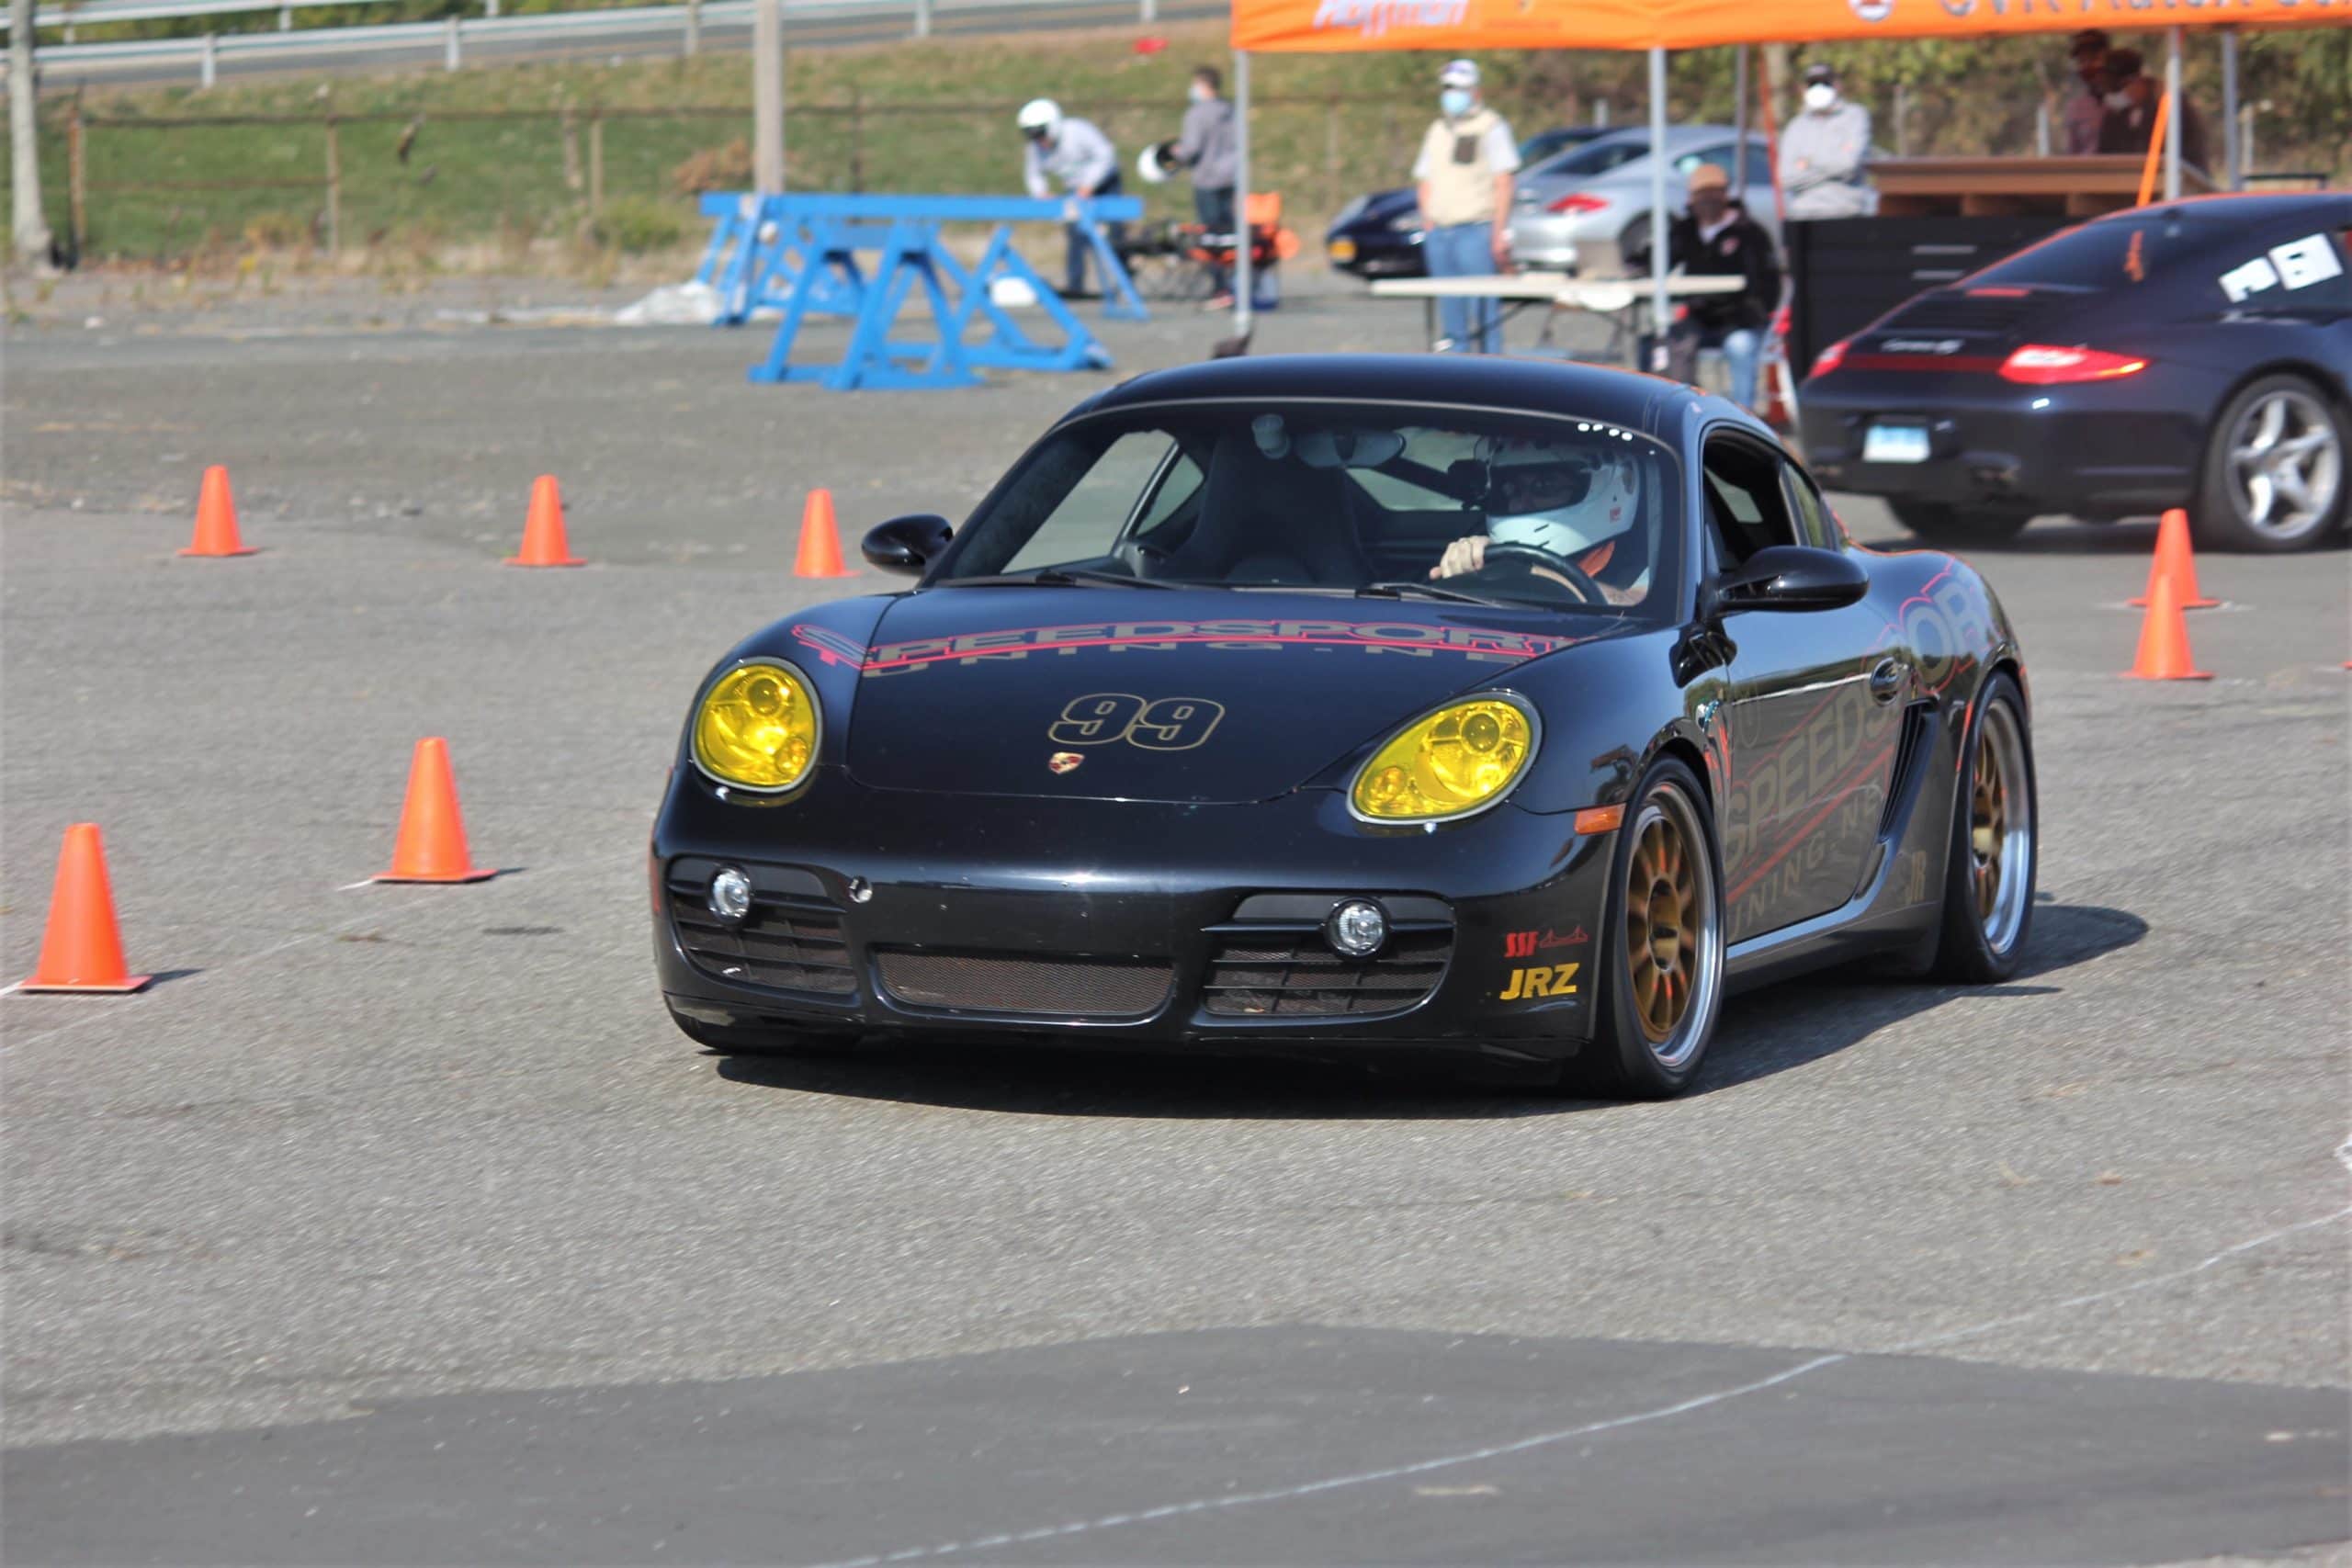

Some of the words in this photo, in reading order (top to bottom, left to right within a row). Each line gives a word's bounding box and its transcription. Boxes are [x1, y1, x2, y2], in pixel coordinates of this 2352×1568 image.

[1047, 693, 1226, 750] 99
[1504, 931, 1539, 958] SSF
[1499, 963, 1580, 1000] JRZ
